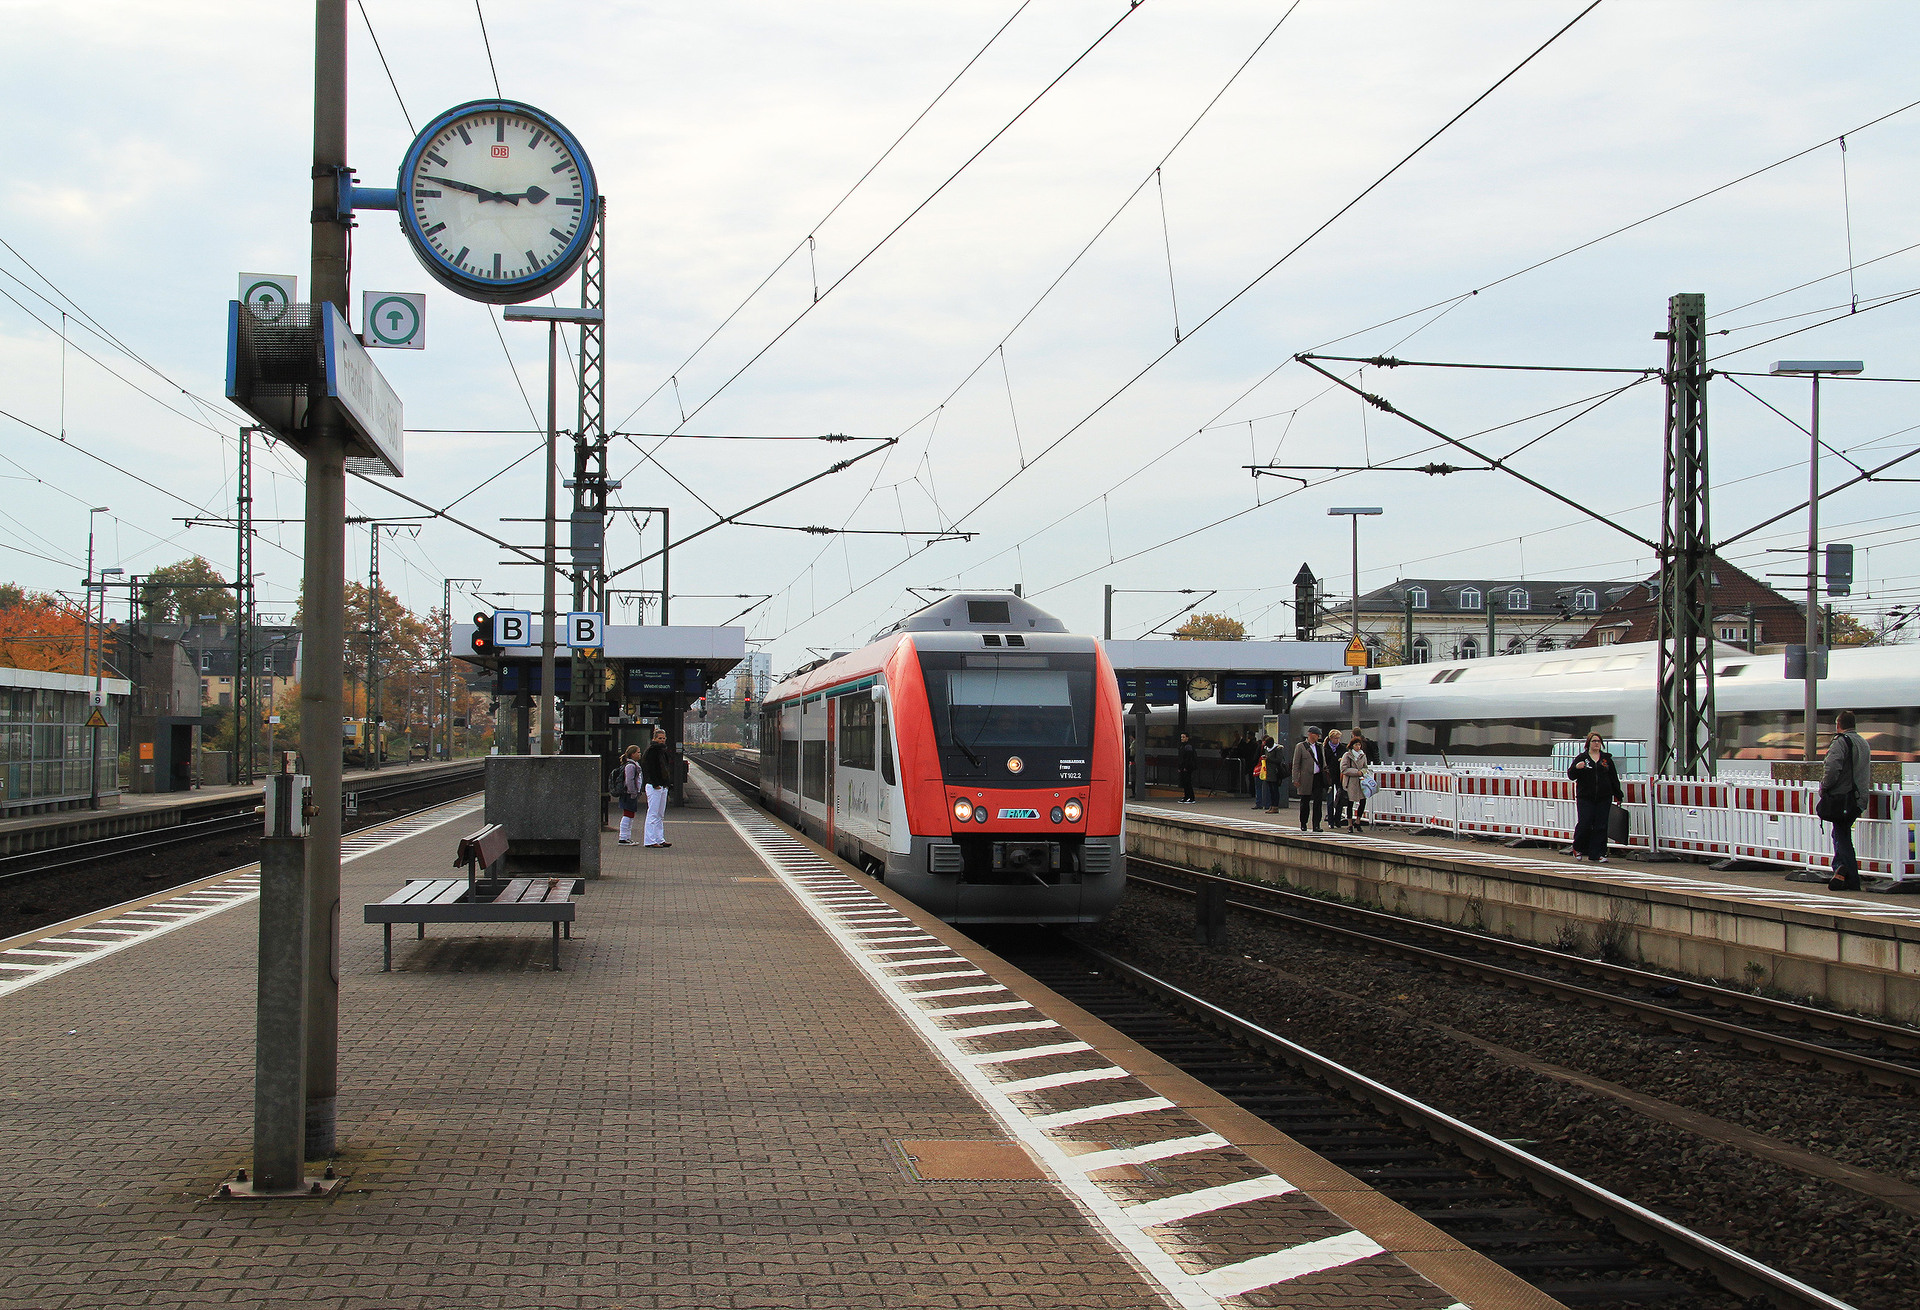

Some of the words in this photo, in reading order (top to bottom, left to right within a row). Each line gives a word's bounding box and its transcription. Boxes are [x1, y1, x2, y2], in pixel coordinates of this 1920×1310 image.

[494, 147, 507, 157] DB
[503, 617, 522, 640] B
[576, 619, 595, 642] B
[502, 666, 509, 675] 8
[696, 668, 702, 677] 7
[1283, 679, 1289, 687] 5
[95, 696, 101, 704] 9
[1006, 809, 1033, 818] RMV
